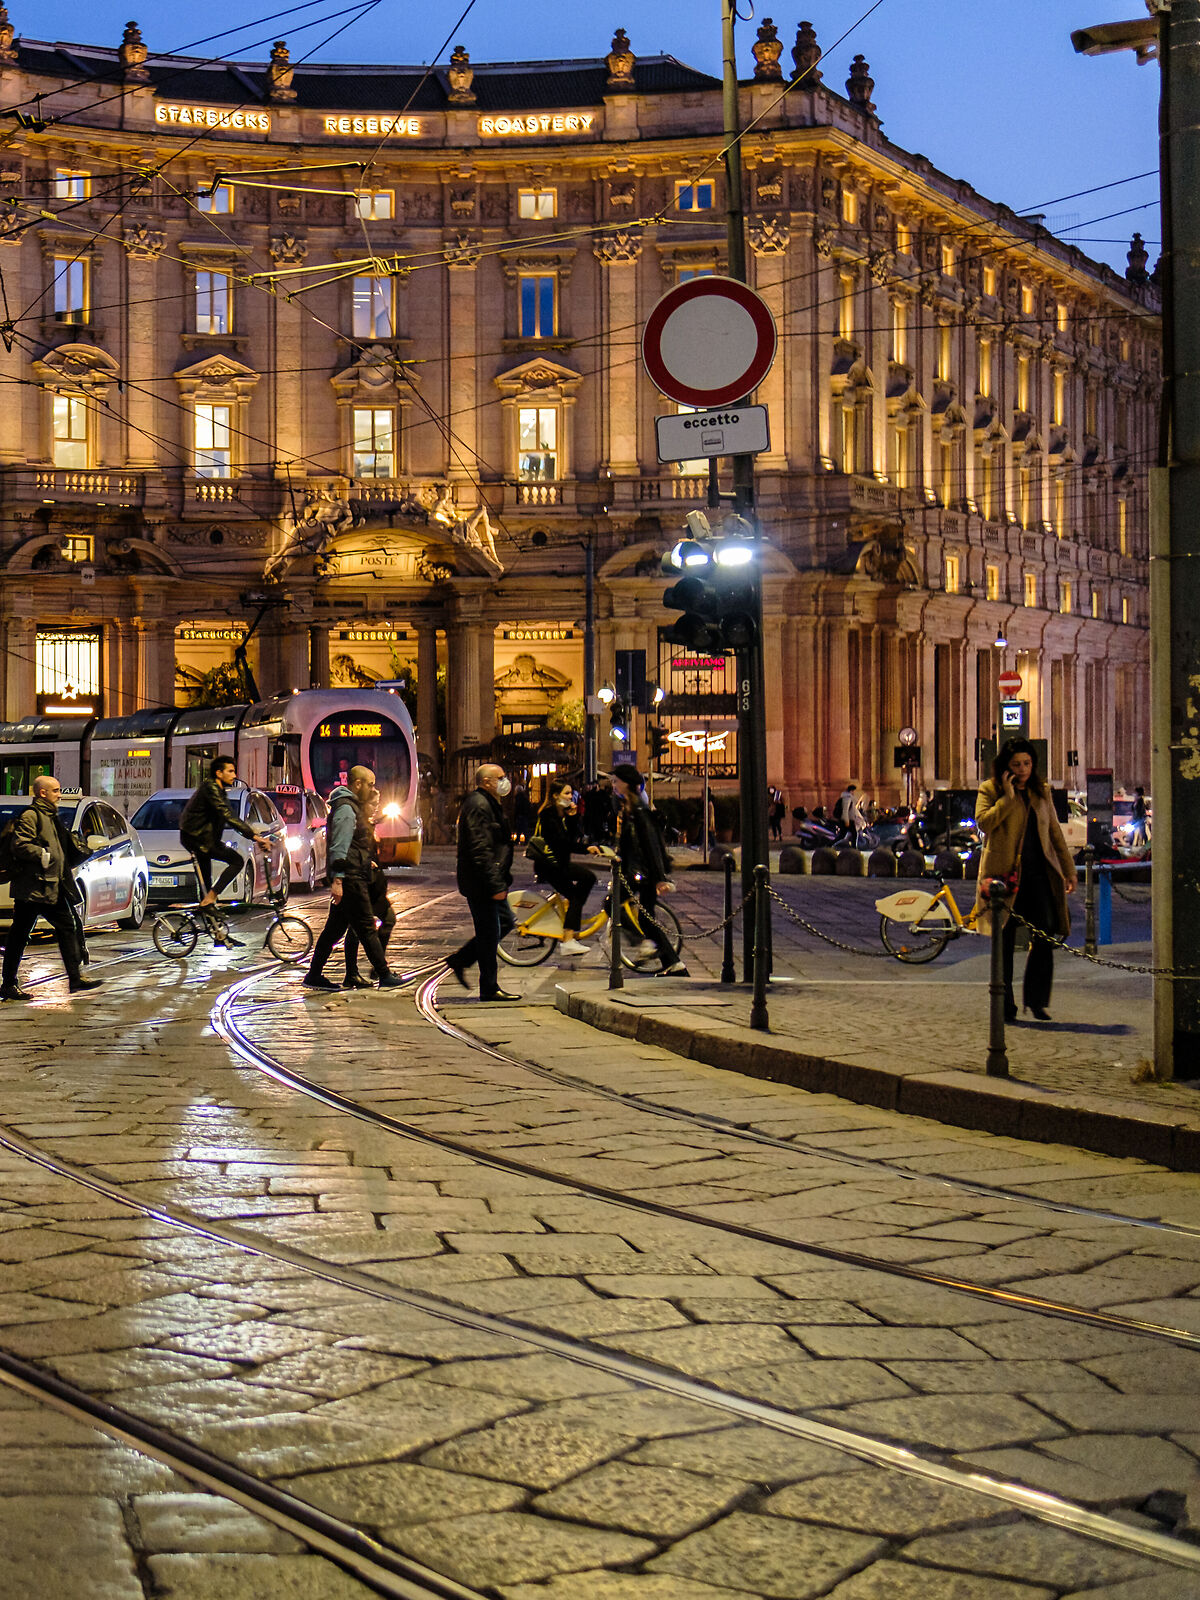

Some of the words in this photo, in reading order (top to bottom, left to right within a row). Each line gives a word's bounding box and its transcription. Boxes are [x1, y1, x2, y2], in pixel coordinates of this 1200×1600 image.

[156, 106, 270, 130] STARBUCKS
[325, 117, 420, 135] RESERVE
[481, 115, 593, 134] ROASTERY
[683, 413, 740, 429] eccetto
[360, 556, 397, 566] POSTE
[184, 630, 243, 640] STARBUCKS
[348, 631, 397, 641] RESERVE
[509, 630, 567, 640] ROASTERY
[320, 724, 331, 737] 14
[349, 724, 382, 737] MAGGIORE
[125, 767, 152, 779] MILANO
[278, 785, 298, 793] TAXI
